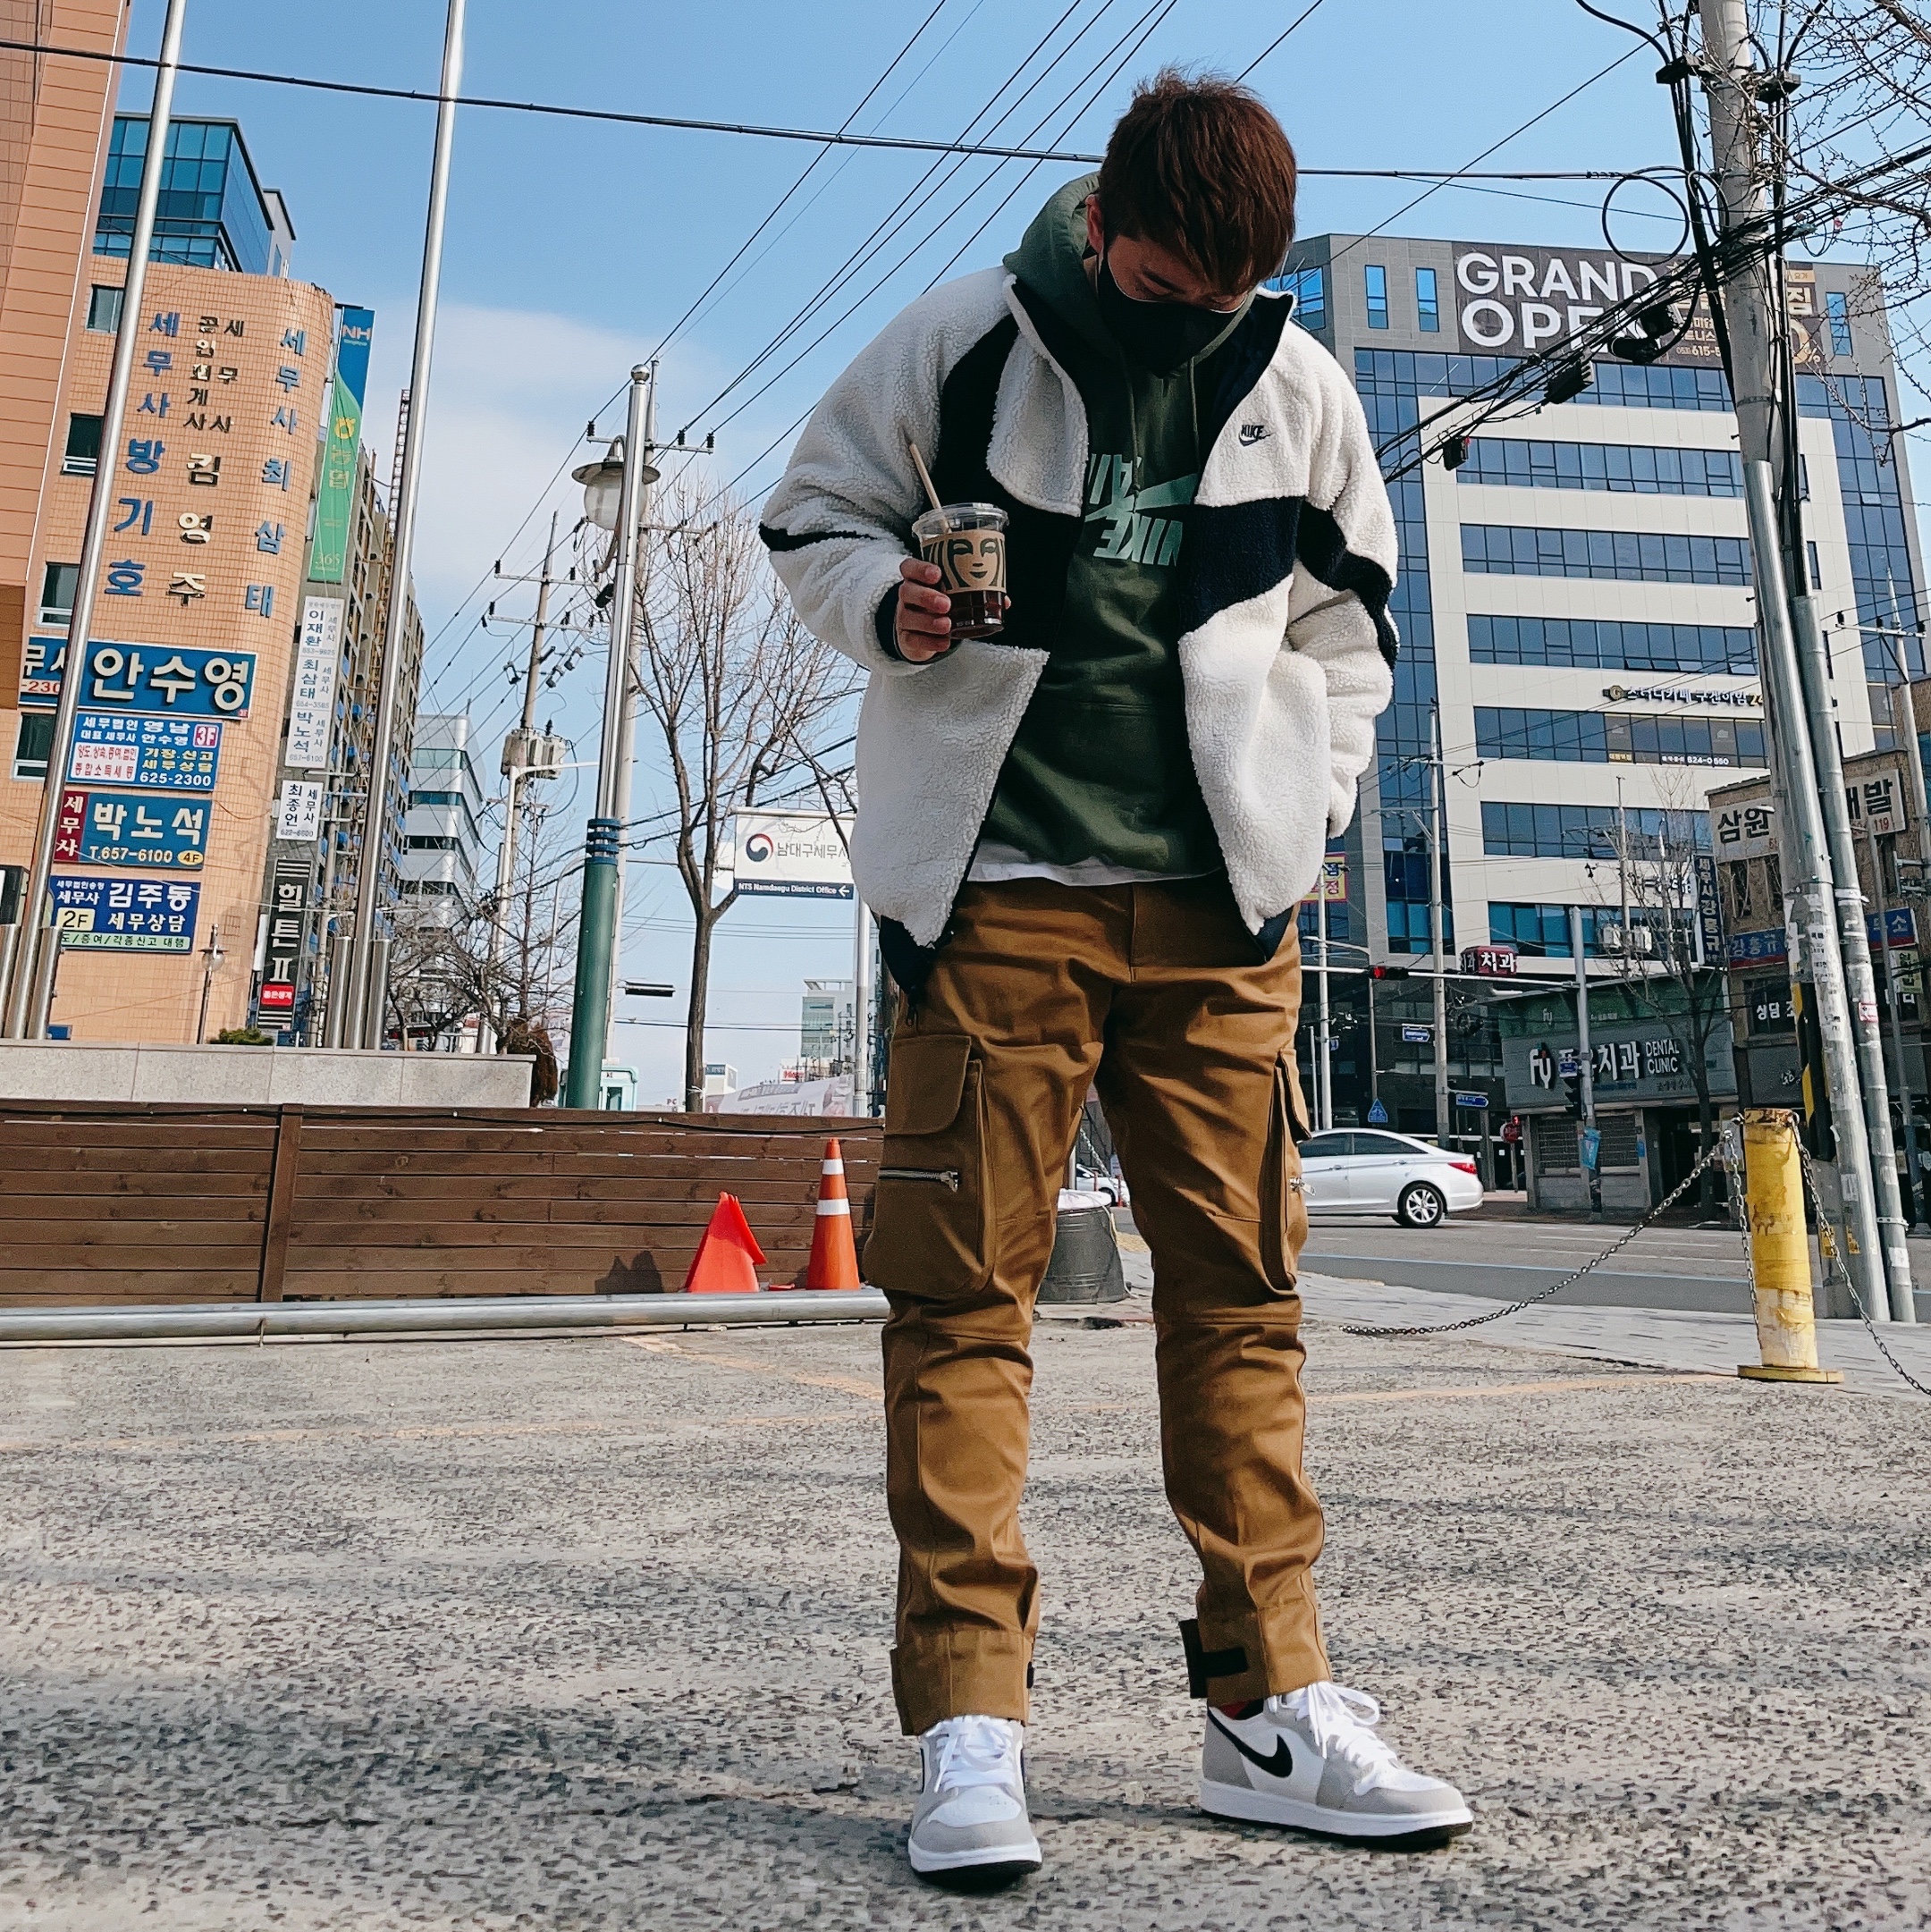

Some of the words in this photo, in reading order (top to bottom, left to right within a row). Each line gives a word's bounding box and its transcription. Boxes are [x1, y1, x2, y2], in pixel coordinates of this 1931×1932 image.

[1456, 251, 1658, 304] GRAND
[342, 324, 372, 341] NH
[1461, 299, 1663, 358] OPE
[137, 312, 180, 418] 세무사
[271, 328, 307, 434] 세무사
[1240, 424, 1265, 441] NIKE
[105, 438, 165, 596] 방기호
[166, 453, 221, 606] 김영주
[245, 457, 291, 619] 최삼태
[93, 648, 249, 711] 안수영
[300, 660, 318, 699] 최삼태
[320, 666, 332, 694] 세무사
[80, 730, 102, 740] 대표
[105, 730, 136, 743] 세무사
[141, 734, 189, 746] 안수영
[83, 716, 139, 731] 세무법인
[143, 720, 190, 735] 영남
[196, 726, 216, 747] 3F
[294, 712, 314, 753] 박노석
[314, 719, 325, 747] 세무사
[139, 772, 212, 787] 625-2300
[141, 760, 214, 773] 세무상담
[285, 784, 302, 827] 최종언
[304, 789, 317, 823] 세무사
[55, 796, 84, 856] 세무사
[93, 802, 204, 846] 박노석
[1717, 808, 1770, 844] 삼원
[181, 852, 200, 863] 4F
[56, 890, 100, 906] 세무사
[108, 882, 192, 912] 김주동
[738, 882, 753, 890] NTS
[753, 883, 790, 894] Namdaegu
[790, 885, 814, 894] District
[815, 886, 838, 894] Office
[62, 910, 89, 928] 2F
[108, 912, 186, 932] 세무상담
[1480, 952, 1516, 973] 치과
[1645, 1039, 1680, 1058] DENTAL
[1647, 1057, 1678, 1074] CLINIC
